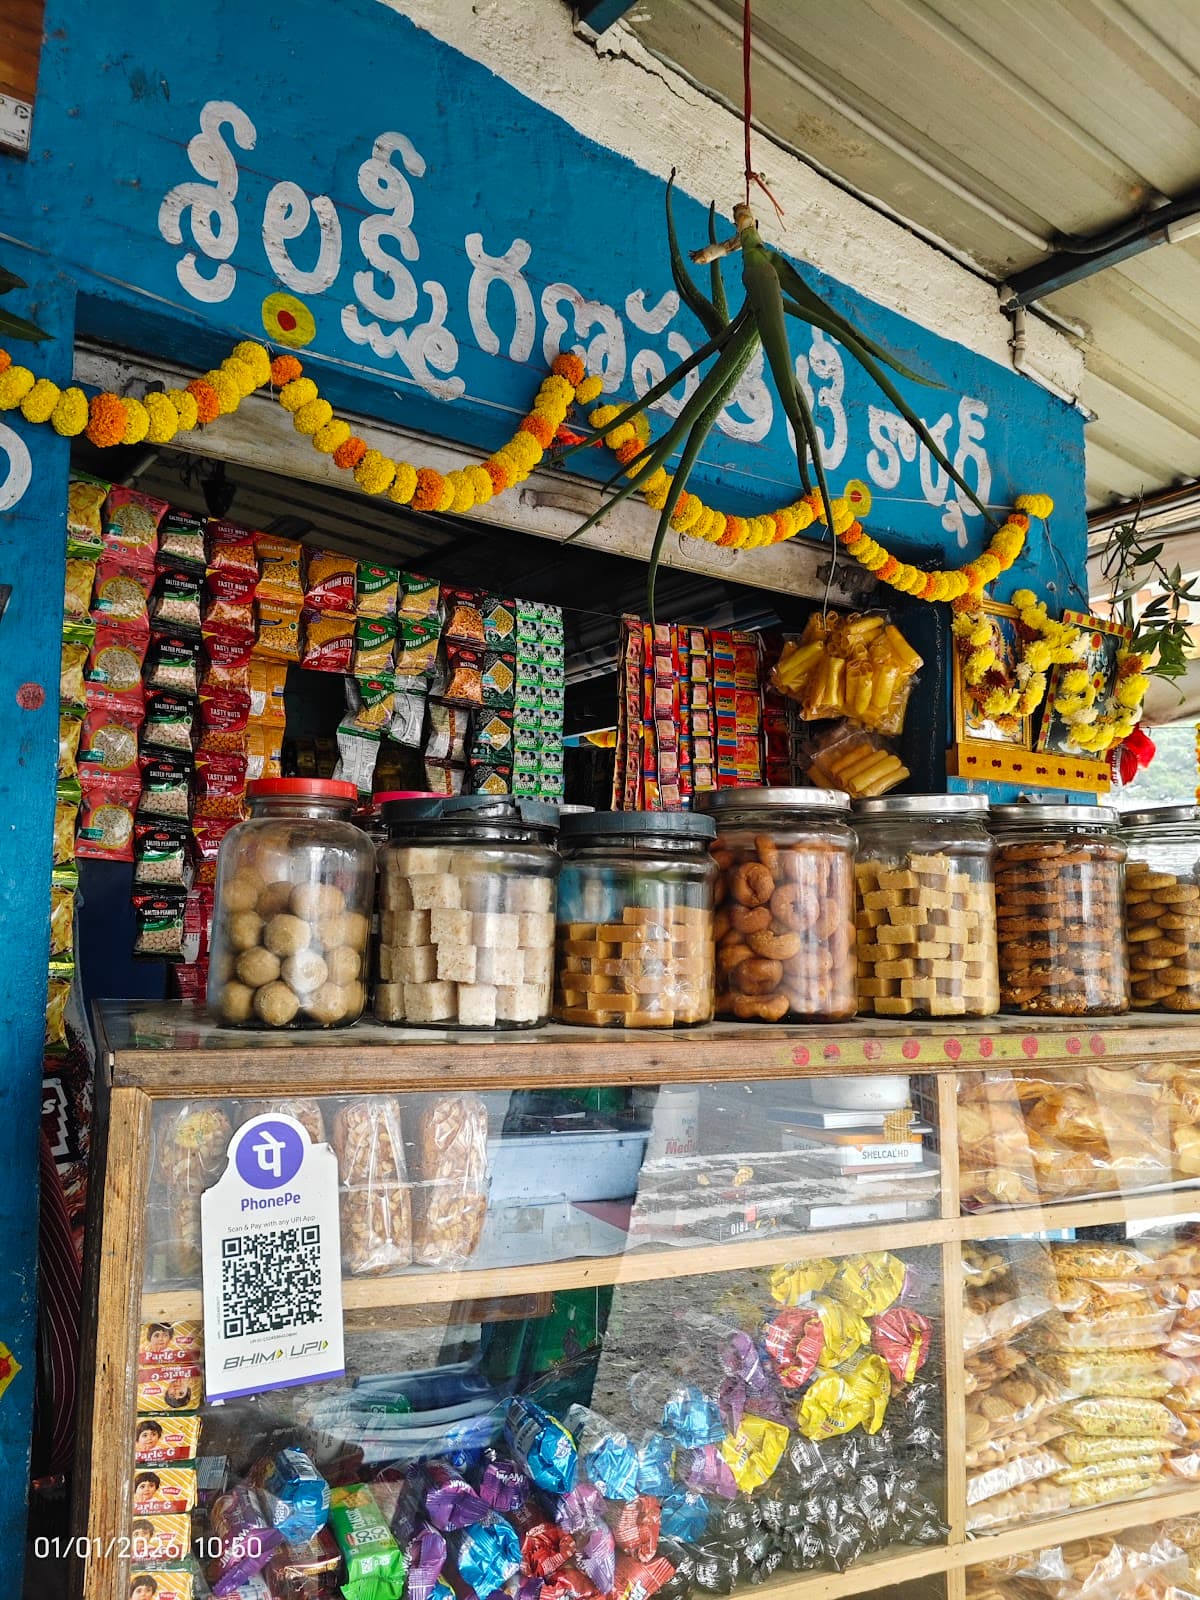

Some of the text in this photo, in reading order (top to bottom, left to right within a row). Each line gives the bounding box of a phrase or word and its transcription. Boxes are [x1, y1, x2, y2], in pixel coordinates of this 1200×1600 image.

[158, 100, 257, 303] శ్రీ
[897, 1148, 910, 1158] HD
[240, 1191, 301, 1212] PhonePe
[227, 1225, 243, 1233] Scan
[250, 1223, 262, 1231] Pay
[263, 1220, 278, 1228] with
[278, 1218, 290, 1226] any
[290, 1215, 302, 1224] UPI
[302, 1214, 316, 1223] App
[223, 1349, 276, 1370] BHIM
[290, 1340, 322, 1357] UPI
